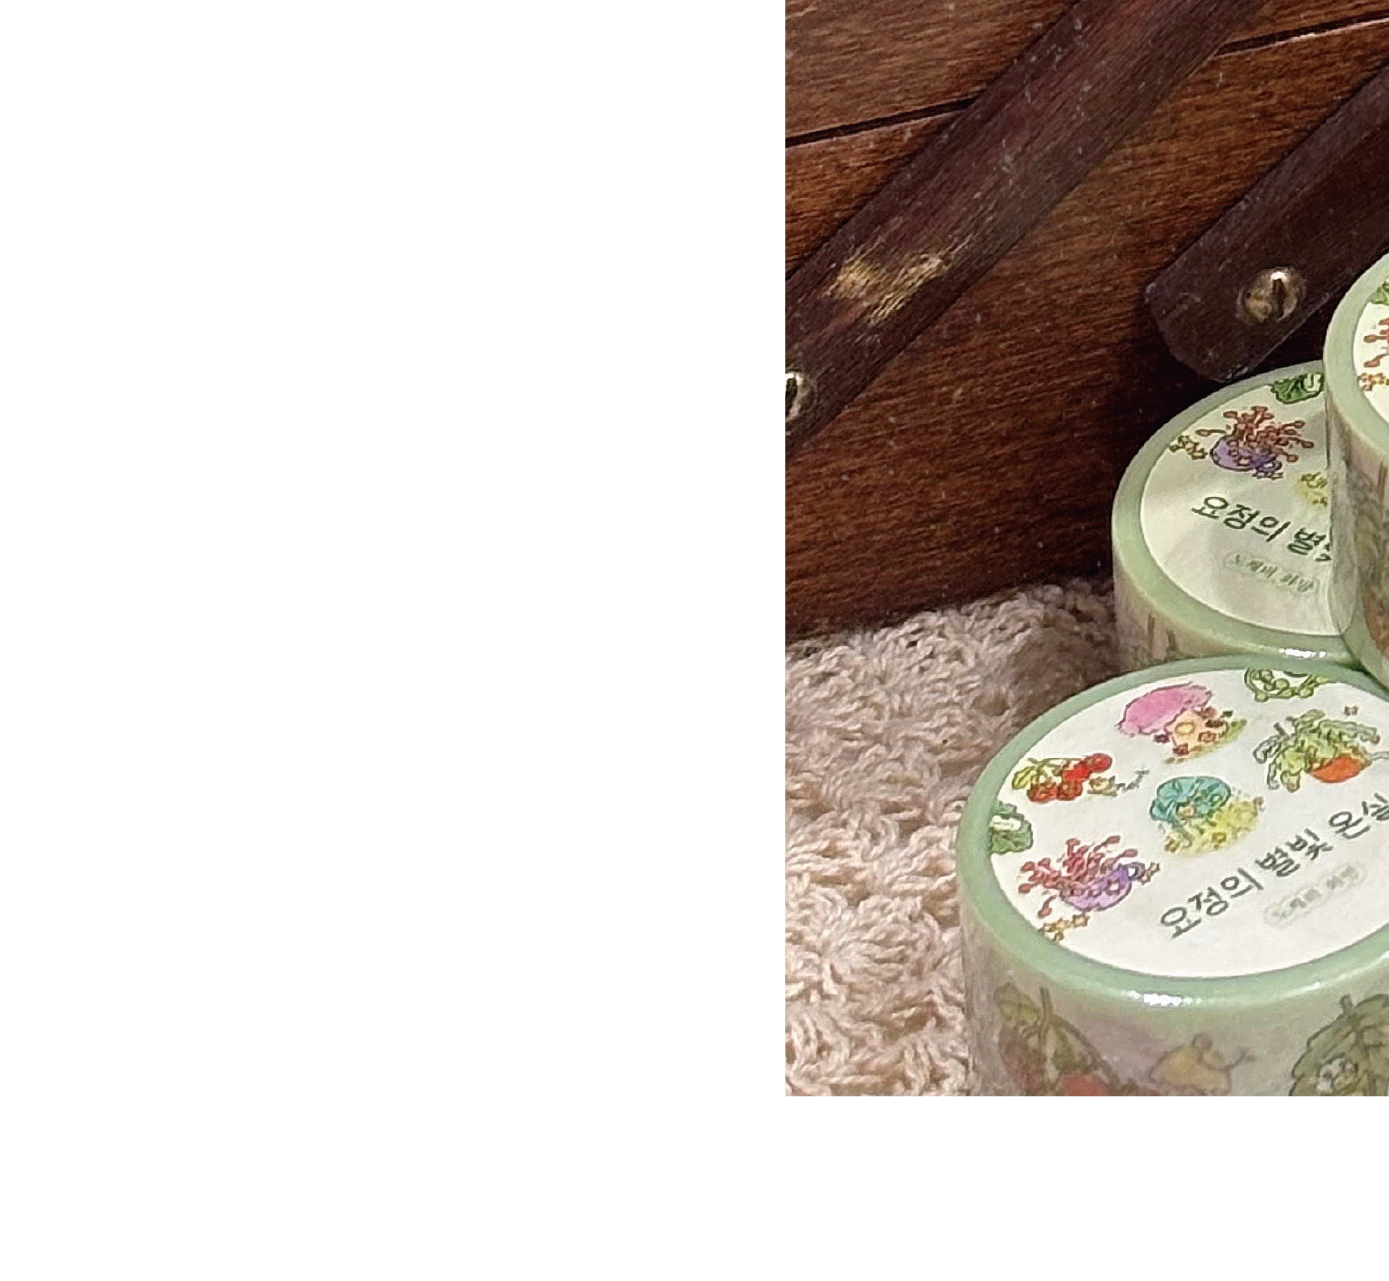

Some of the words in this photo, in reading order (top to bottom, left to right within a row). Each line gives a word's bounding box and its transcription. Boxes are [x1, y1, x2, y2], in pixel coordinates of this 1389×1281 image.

[1190, 495, 1293, 543] 요정의
[1159, 867, 1264, 939] 요정의
[1254, 827, 1335, 878] 별빛
